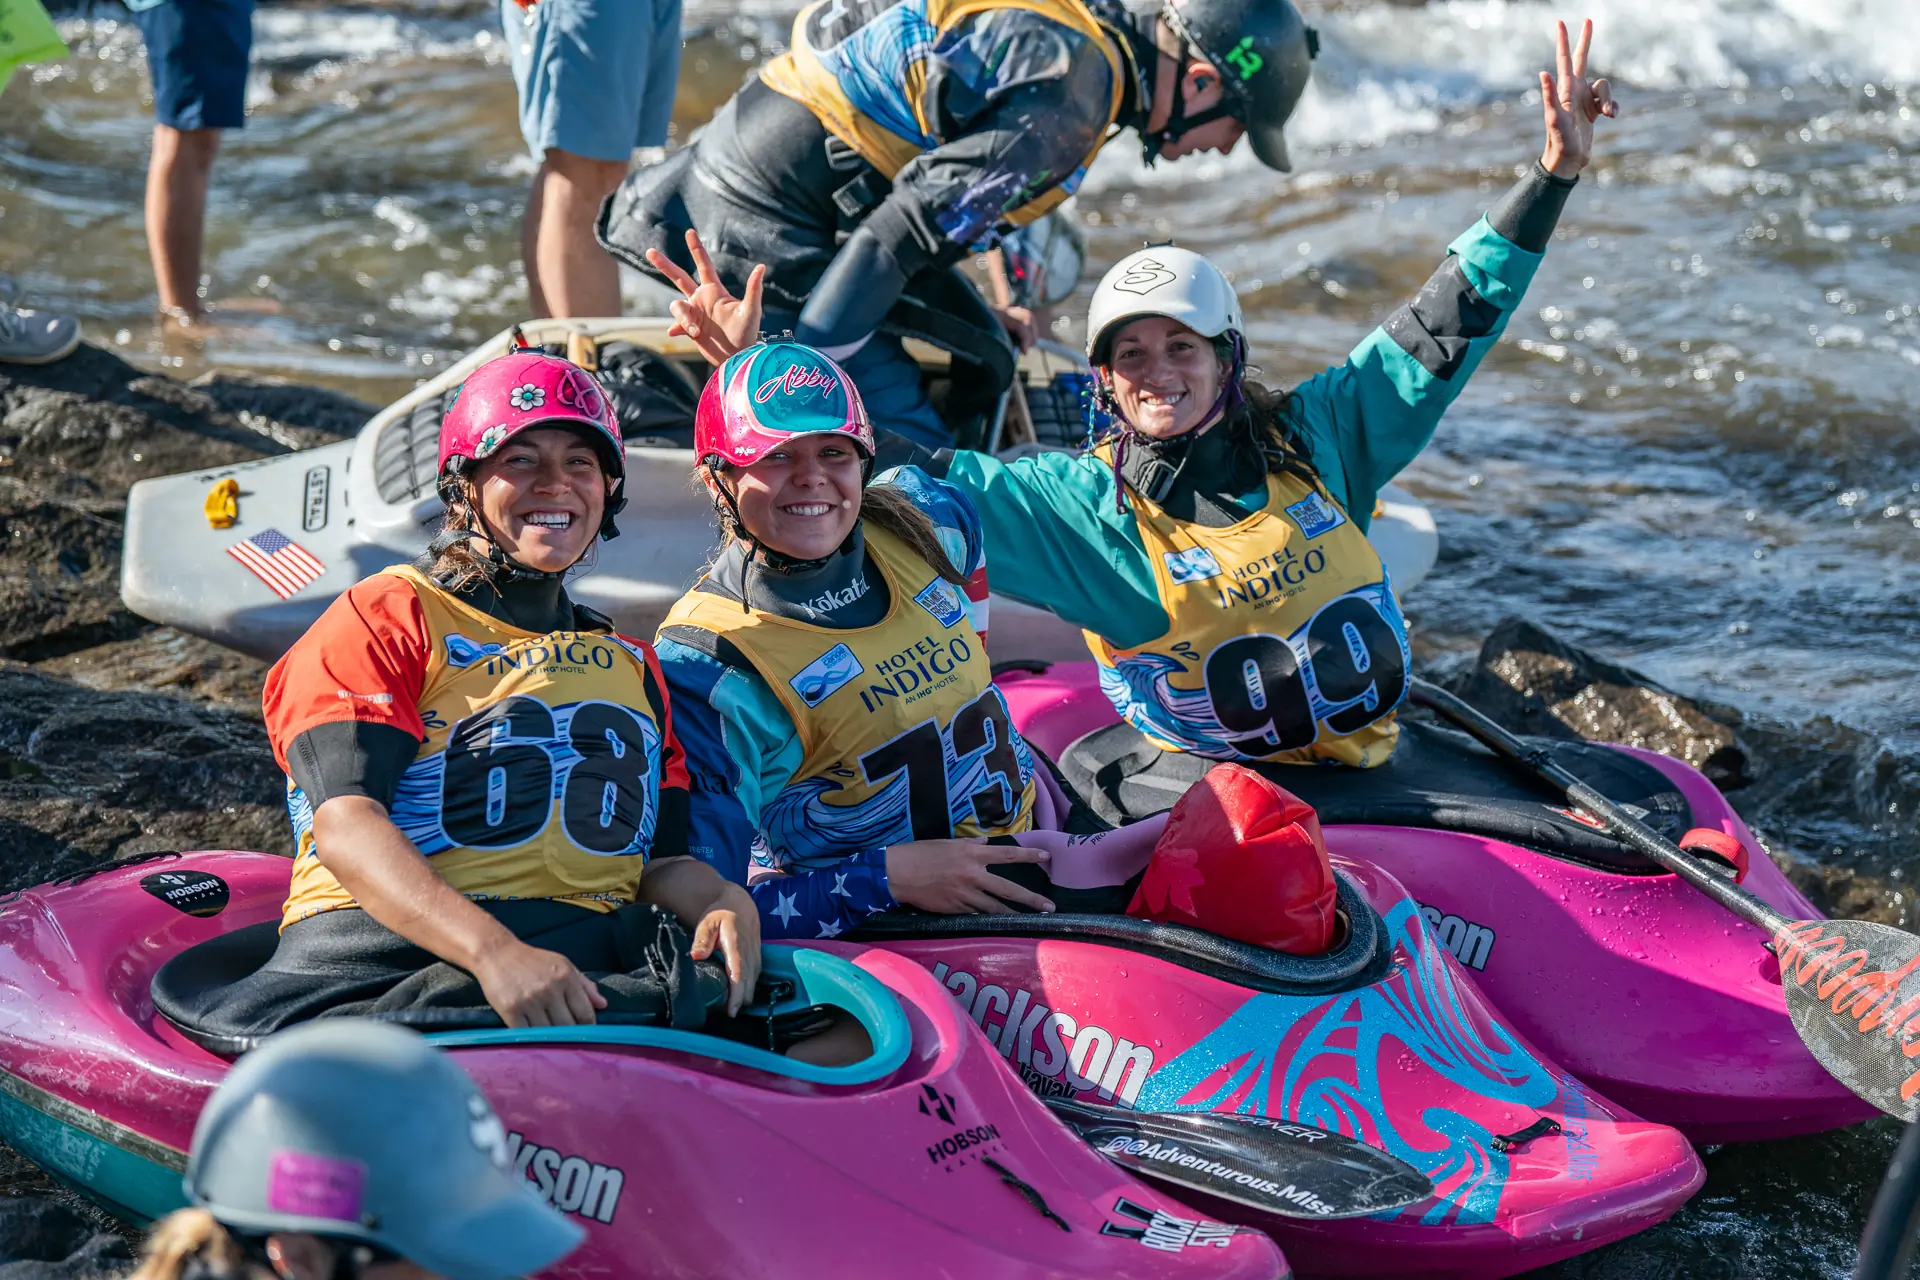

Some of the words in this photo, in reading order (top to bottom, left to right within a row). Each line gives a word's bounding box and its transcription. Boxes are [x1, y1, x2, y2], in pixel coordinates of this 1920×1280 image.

[755, 364, 839, 404] Abby
[1217, 547, 1325, 610] INDIGO
[1233, 547, 1297, 581] HOTEL
[1253, 601, 1265, 611] AN
[1282, 585, 1307, 600] HOTEL
[487, 642, 615, 676] INDIGO
[524, 669, 537, 677] AN
[559, 666, 587, 675] HOTEL
[859, 634, 971, 714] INDIGO
[875, 636, 940, 676] HOTEL
[1203, 593, 1407, 758] 99
[905, 695, 917, 706] AN
[916, 686, 933, 700] IHG
[933, 674, 959, 690] HOTEL
[440, 693, 651, 856] 68
[857, 684, 1030, 842] 73
[165, 879, 220, 900] HOBSON
[926, 1123, 1001, 1165] HOBSON
[1125, 1137, 1336, 1216] @Adventurous.Miss
[1139, 1208, 1198, 1253] ROCK
